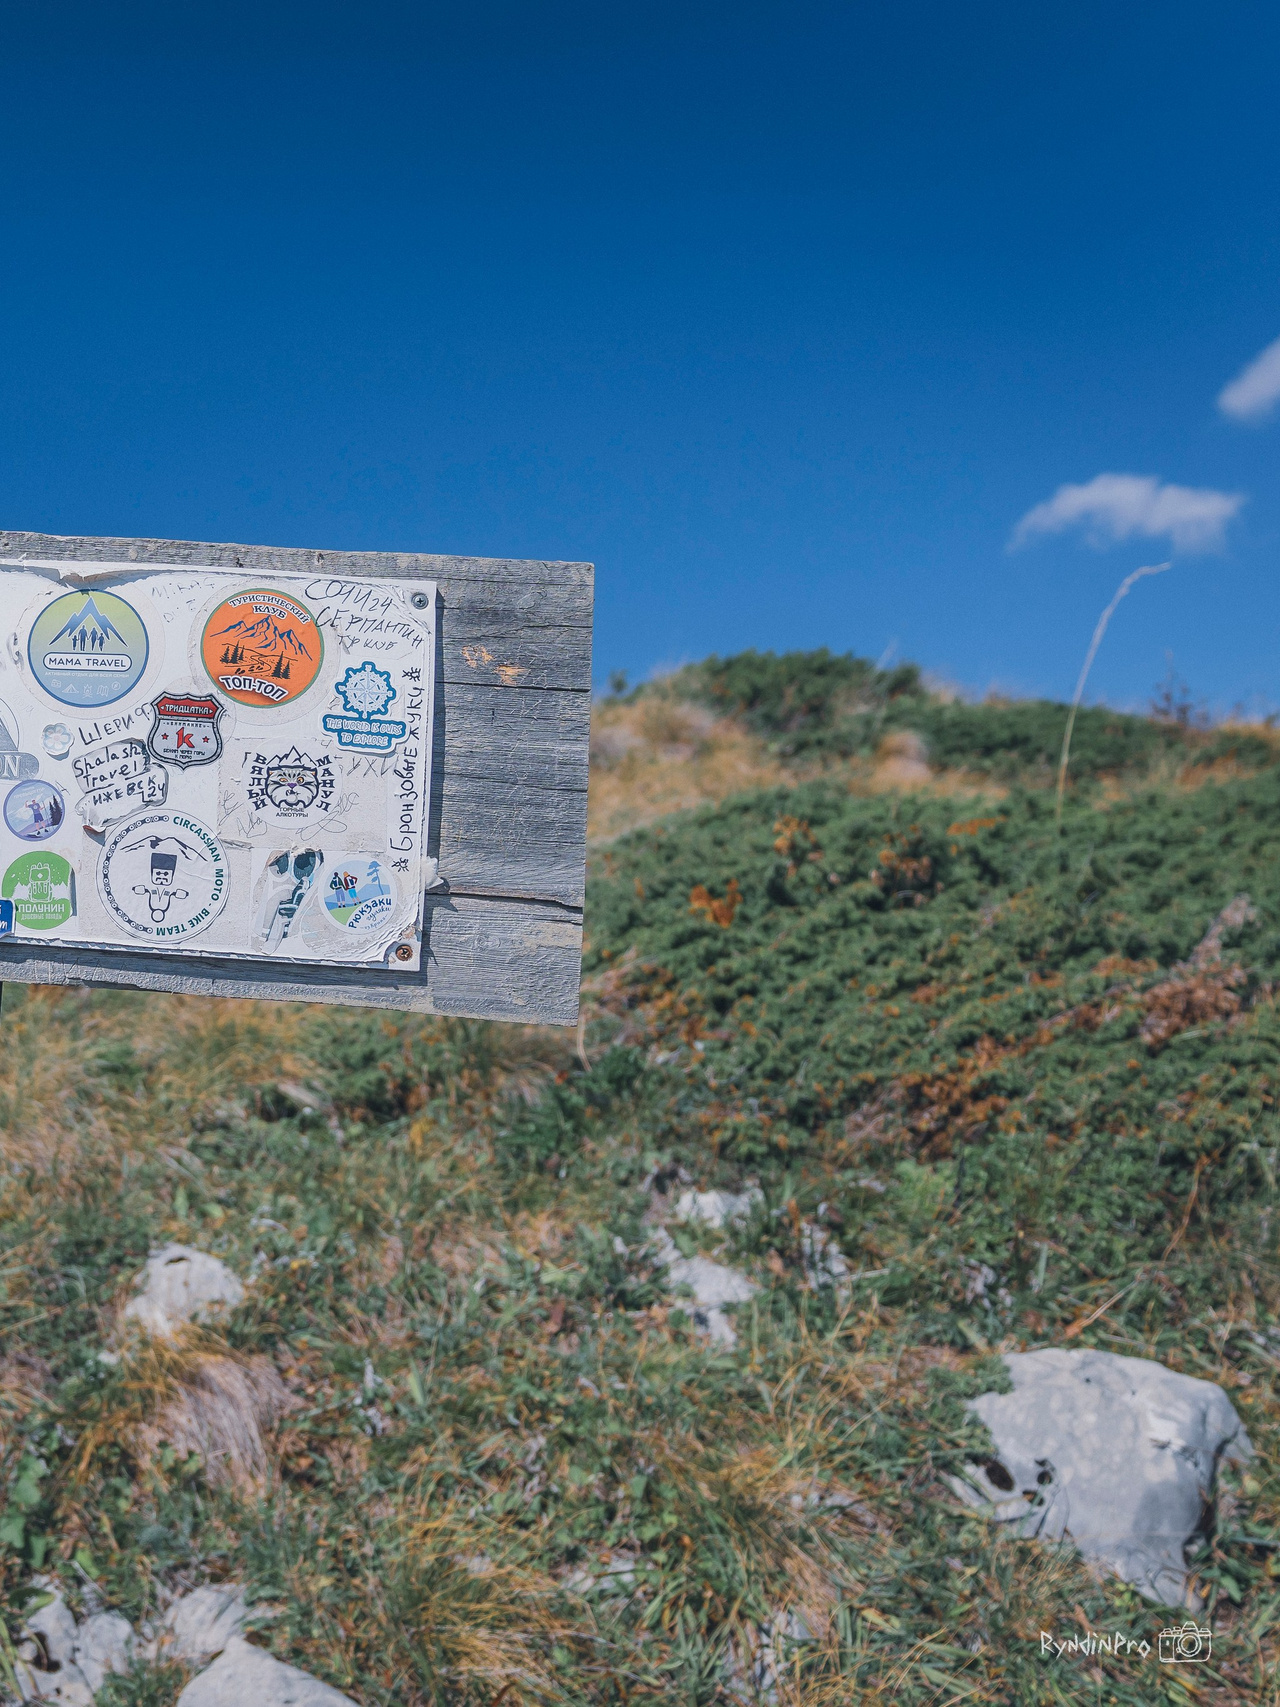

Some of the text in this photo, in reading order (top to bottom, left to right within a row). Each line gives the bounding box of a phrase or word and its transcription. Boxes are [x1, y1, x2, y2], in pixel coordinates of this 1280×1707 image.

[229, 594, 311, 624] ТУРИСТИЧЕСКИЙ
[254, 605, 287, 619] КЛУБ
[48, 657, 127, 668] MAMA TRAVEL
[220, 676, 287, 700] ТОП-ТОП
[165, 704, 209, 715] ТРИДЦАТКА
[326, 718, 403, 735] THE WORLD IS OURS
[341, 732, 389, 747] TO EXPLORE
[246, 752, 268, 811] ВЯЛЫЙ
[316, 754, 336, 812] МАНУЛ
[156, 816, 224, 936] CIRCASSIAN MOTO BIKE TEAM
[18, 903, 65, 913] ПОЛУНИН
